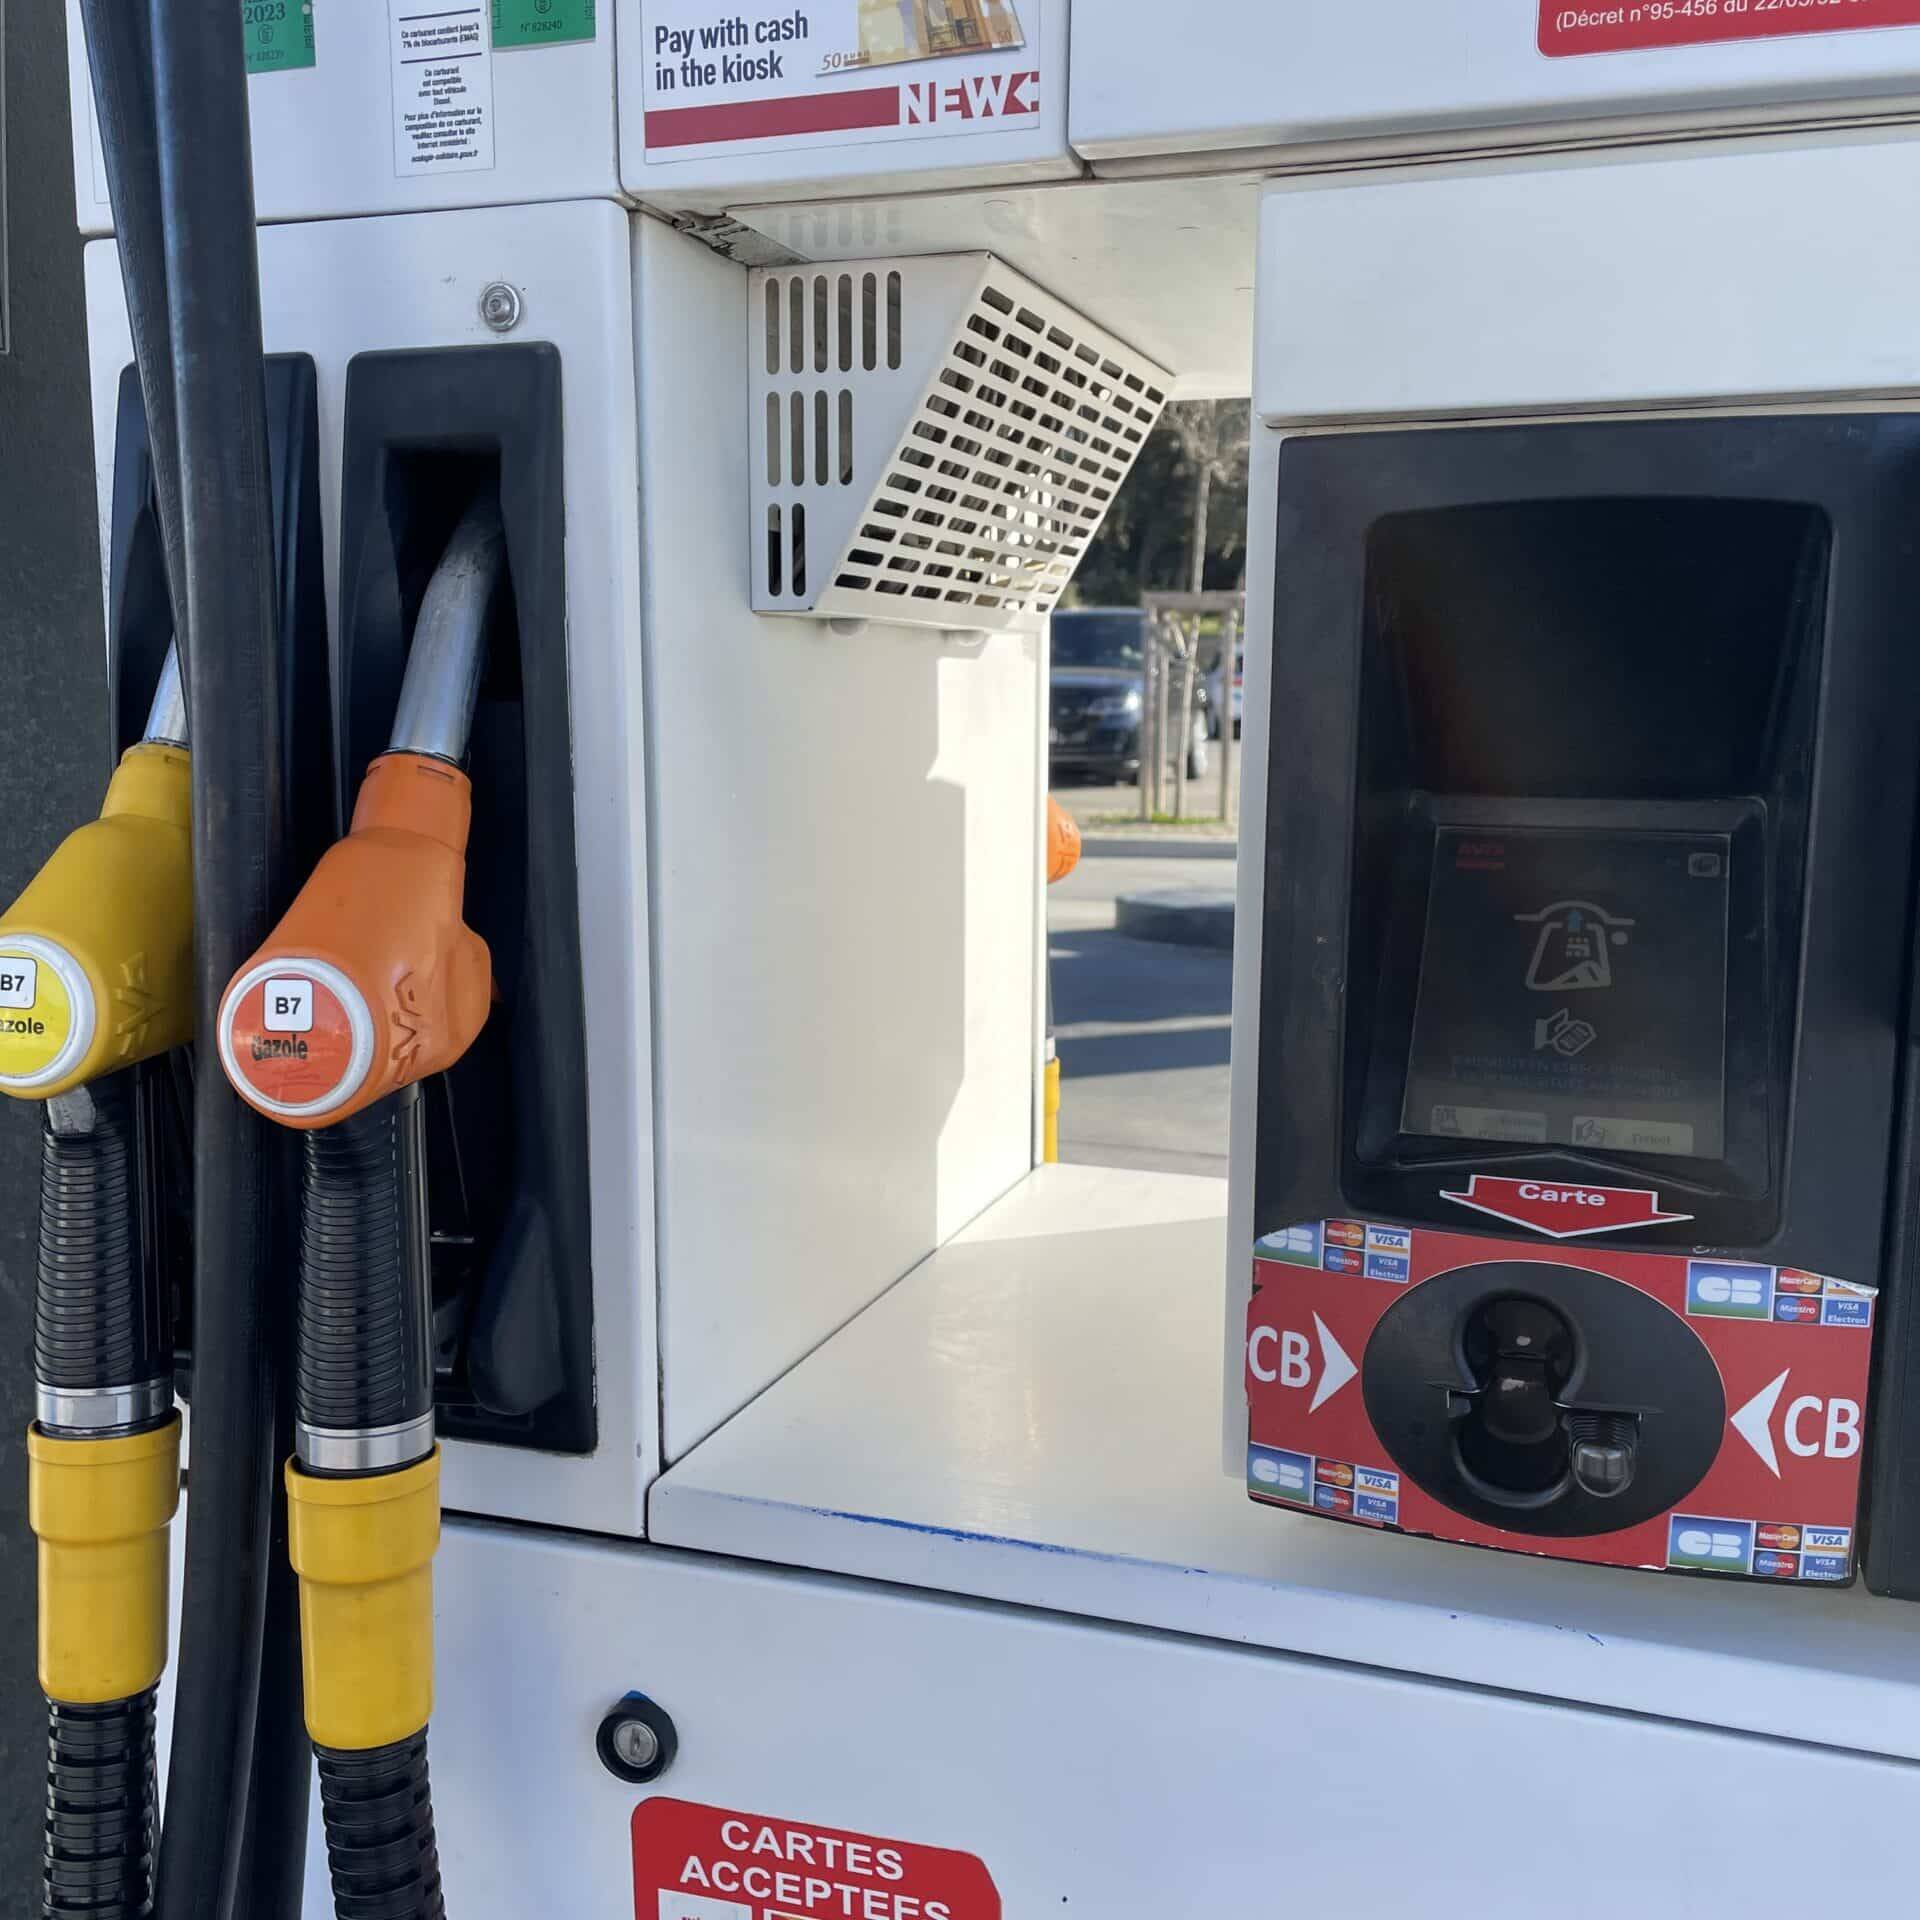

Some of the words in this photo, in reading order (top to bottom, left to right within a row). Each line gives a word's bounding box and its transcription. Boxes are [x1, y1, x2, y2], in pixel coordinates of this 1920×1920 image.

[244, 2, 286, 24] 2023
[1556, 8, 1624, 32] (Décret
[655, 25, 695, 59] Pay
[700, 16, 749, 49] with
[755, 9, 808, 43] cash
[655, 61, 675, 91] in
[680, 58, 716, 88] the
[722, 49, 784, 84] kiosk
[821, 52, 842, 70] 50
[1, 974, 25, 991] B7
[275, 996, 302, 1015] B7
[251, 1033, 308, 1061] Gazole
[1518, 1183, 1607, 1207] Carte
[1374, 1234, 1405, 1247] VISA
[1328, 1255, 1360, 1267] Maestro
[1378, 1257, 1398, 1266] VISA
[1370, 1268, 1406, 1279] Electron
[1779, 1303, 1816, 1315] Maestro
[1836, 1302, 1860, 1312] VISA
[1827, 1314, 1866, 1325] Electron
[1248, 1325, 1312, 1388] CB
[1784, 1395, 1860, 1458] CB
[1363, 1475, 1392, 1490] VISA
[1811, 1534, 1844, 1546] VISA
[1758, 1559, 1794, 1570] Maestro
[1814, 1557, 1837, 1567] VISA
[720, 1819, 904, 1881] CARTES
[679, 1855, 951, 1920] ACCEPTEES
